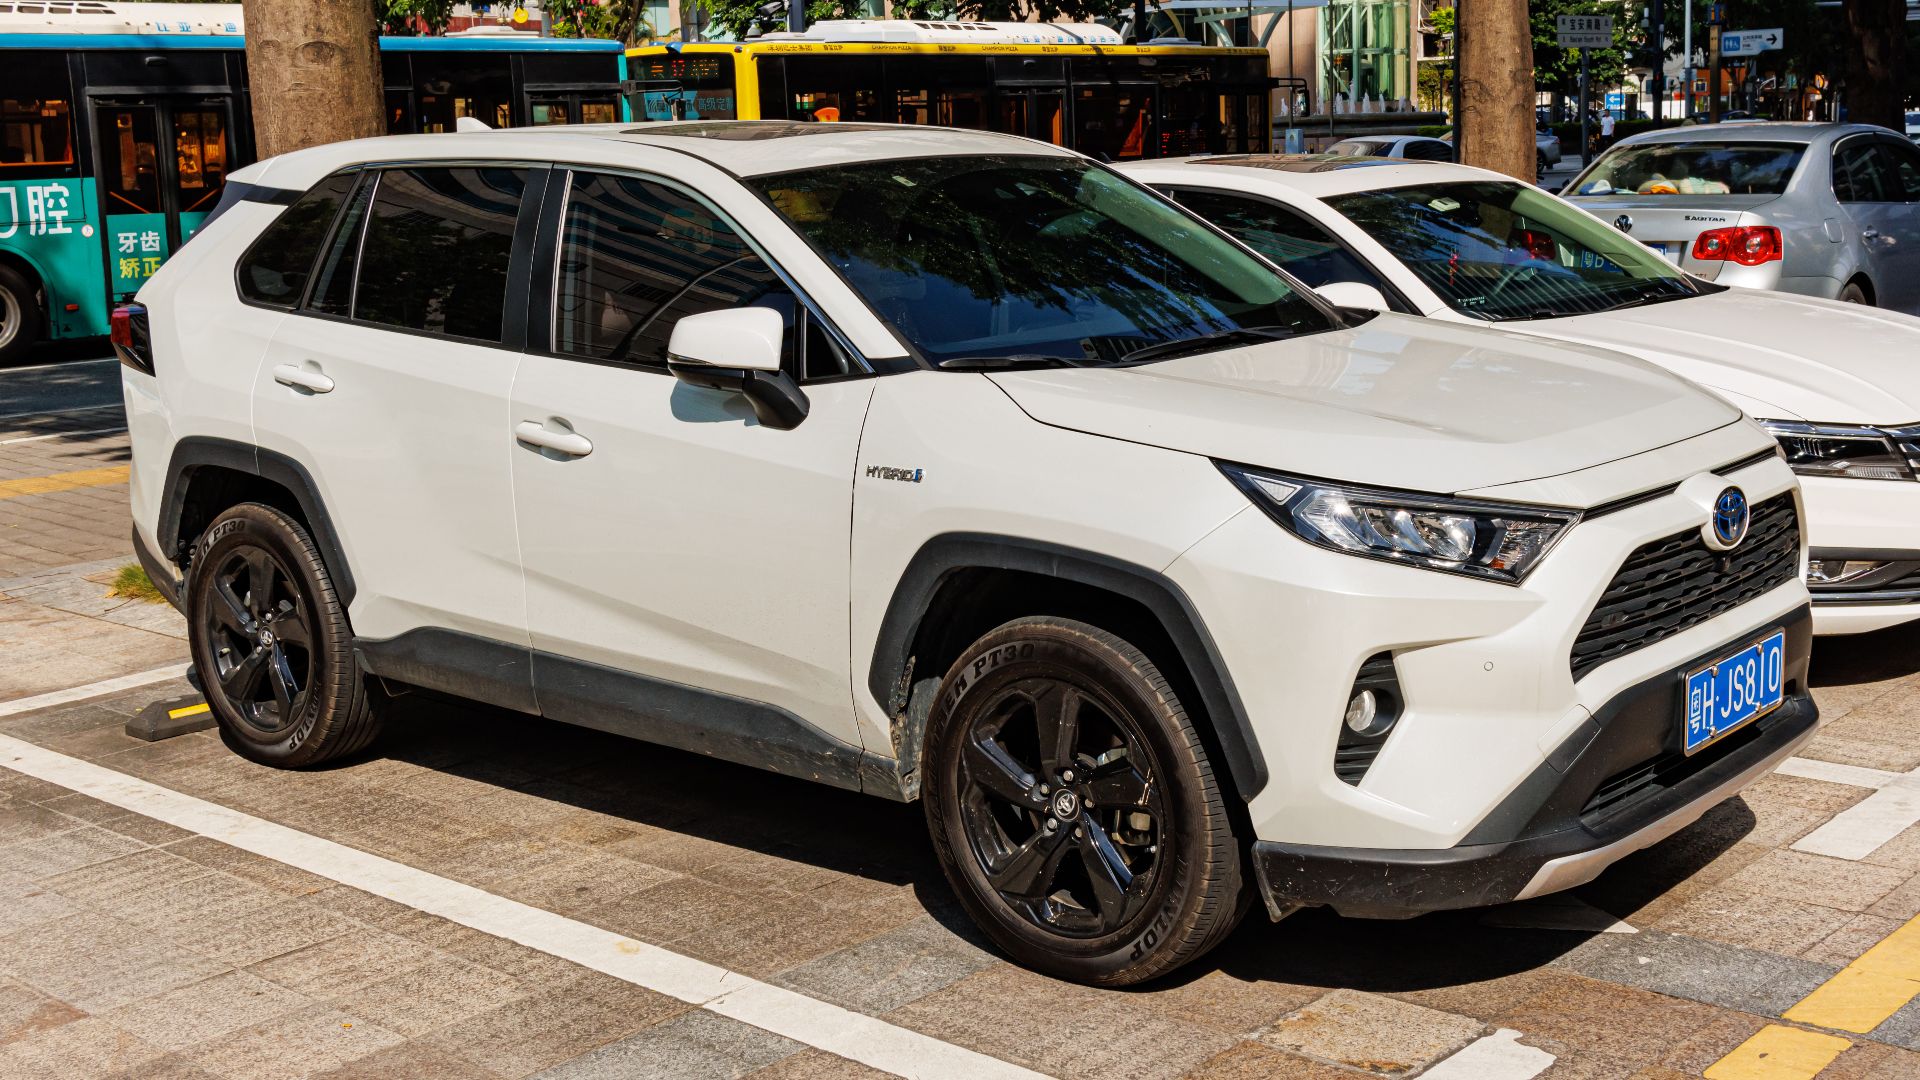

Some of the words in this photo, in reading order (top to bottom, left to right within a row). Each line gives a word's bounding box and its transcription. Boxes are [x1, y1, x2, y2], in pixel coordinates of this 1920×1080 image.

[1570, 18, 1600, 30] 宝安南路
[118, 231, 160, 253] 牙齿
[119, 257, 161, 279] 矫正
[866, 465, 914, 481] HYBRID
[213, 520, 245, 542] PT30
[973, 643, 1035, 678] PT30
